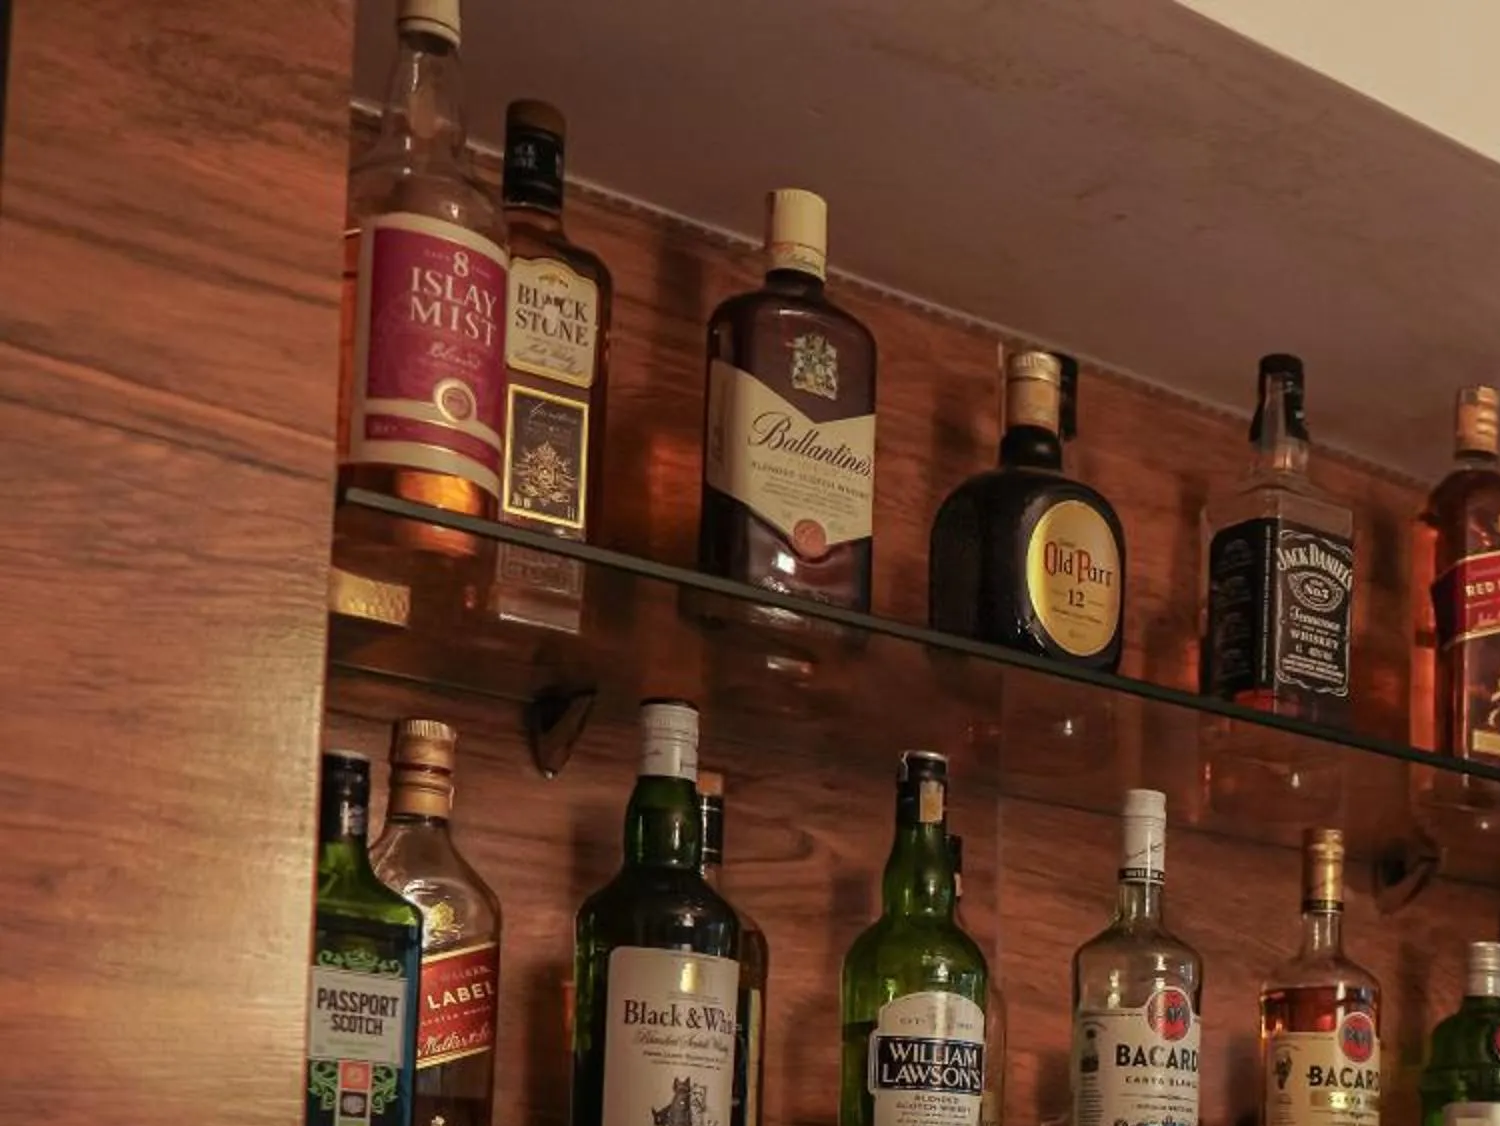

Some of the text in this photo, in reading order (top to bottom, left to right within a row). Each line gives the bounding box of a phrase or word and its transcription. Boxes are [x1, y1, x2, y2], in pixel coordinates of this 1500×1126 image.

[452, 250, 470, 278] 8
[411, 266, 497, 318] ISLAY
[516, 283, 589, 323] BLACK
[409, 296, 497, 348] MIST
[514, 308, 590, 348] STONE
[1043, 540, 1114, 587] Old Parr
[1276, 547, 1309, 572] JACK
[1066, 589, 1086, 609] 12
[1465, 580, 1496, 599] RED
[316, 987, 399, 1019] PASSPORT
[426, 981, 495, 1010] LABEL
[330, 1012, 384, 1037] SCOTCH
[623, 999, 682, 1028] Black
[685, 1007, 702, 1030] &
[889, 1041, 978, 1068] WILLIAM
